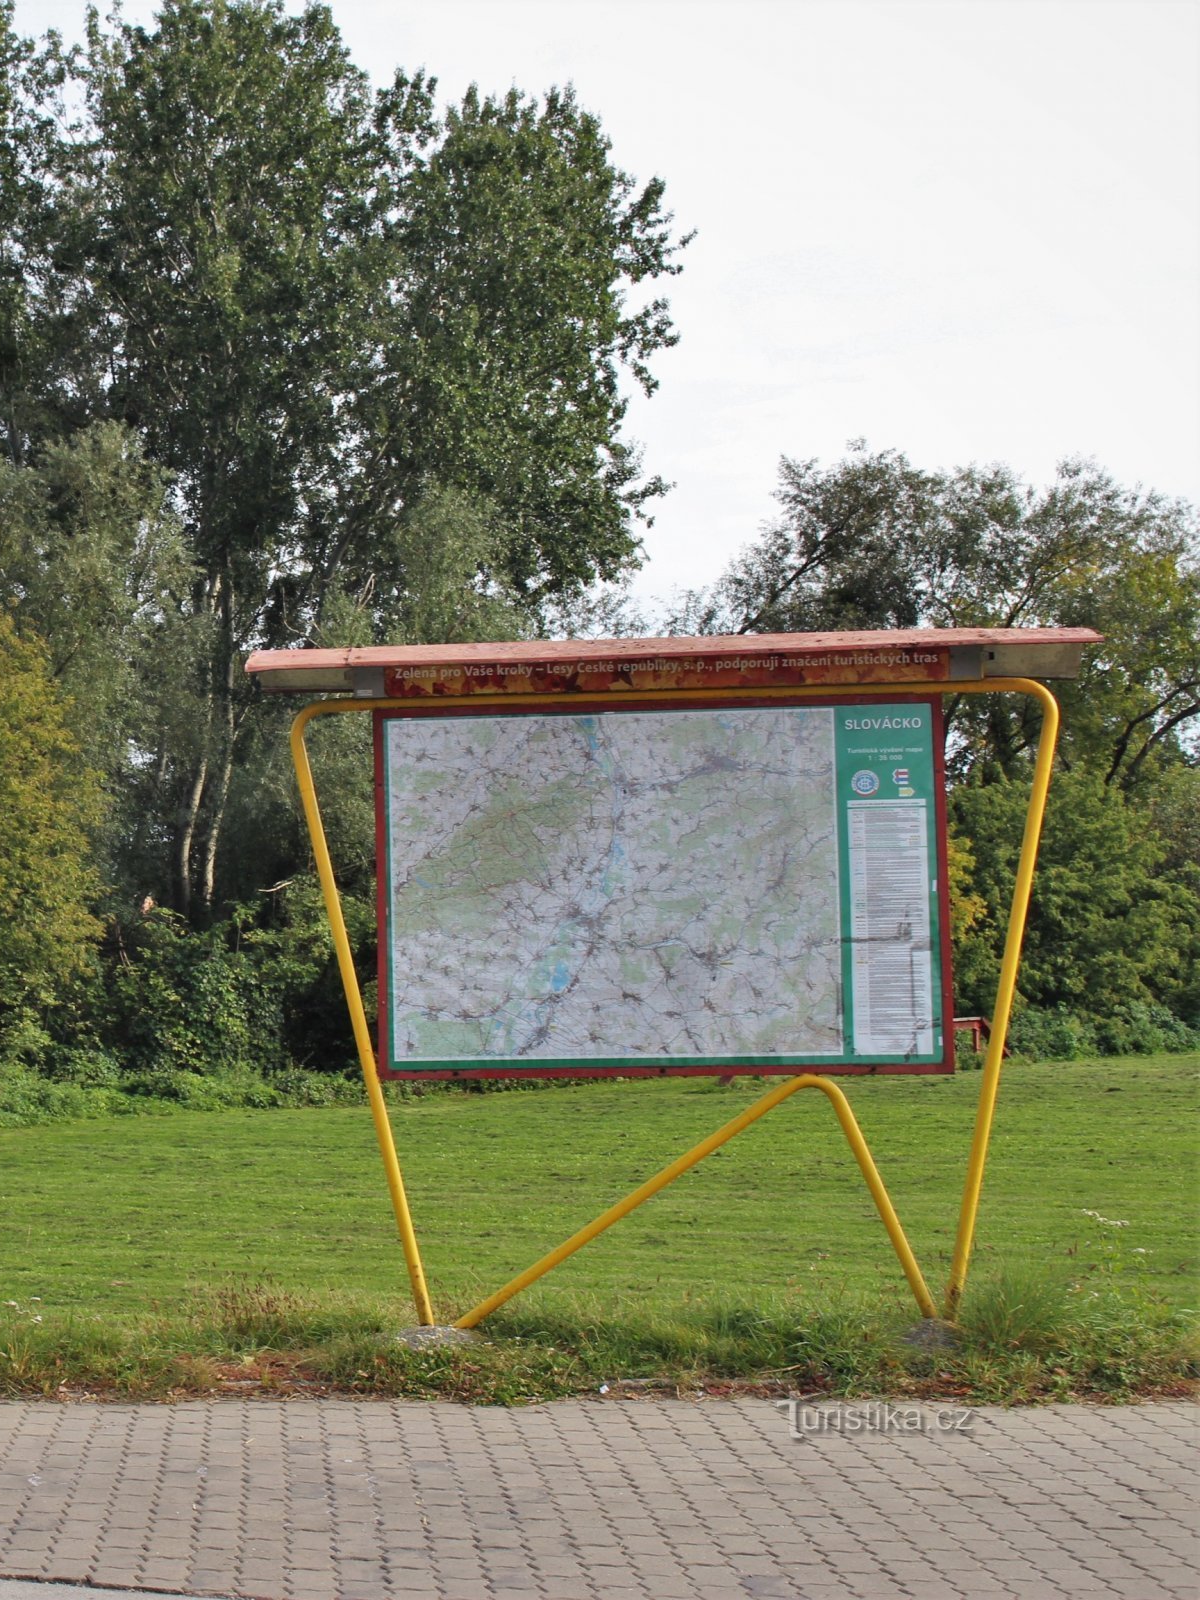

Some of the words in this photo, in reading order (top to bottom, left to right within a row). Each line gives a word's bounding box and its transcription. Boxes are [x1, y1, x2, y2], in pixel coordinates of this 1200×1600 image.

[395, 665, 436, 679] Zelená
[440, 668, 461, 680] pro
[464, 665, 494, 676] Vaše
[497, 664, 533, 678] kroky
[546, 663, 574, 678] Lesy
[715, 656, 779, 672] podporují
[782, 655, 831, 668] značení
[834, 651, 910, 667] turistických
[913, 652, 939, 663] tras
[844, 716, 922, 730] SLOVÁCKO
